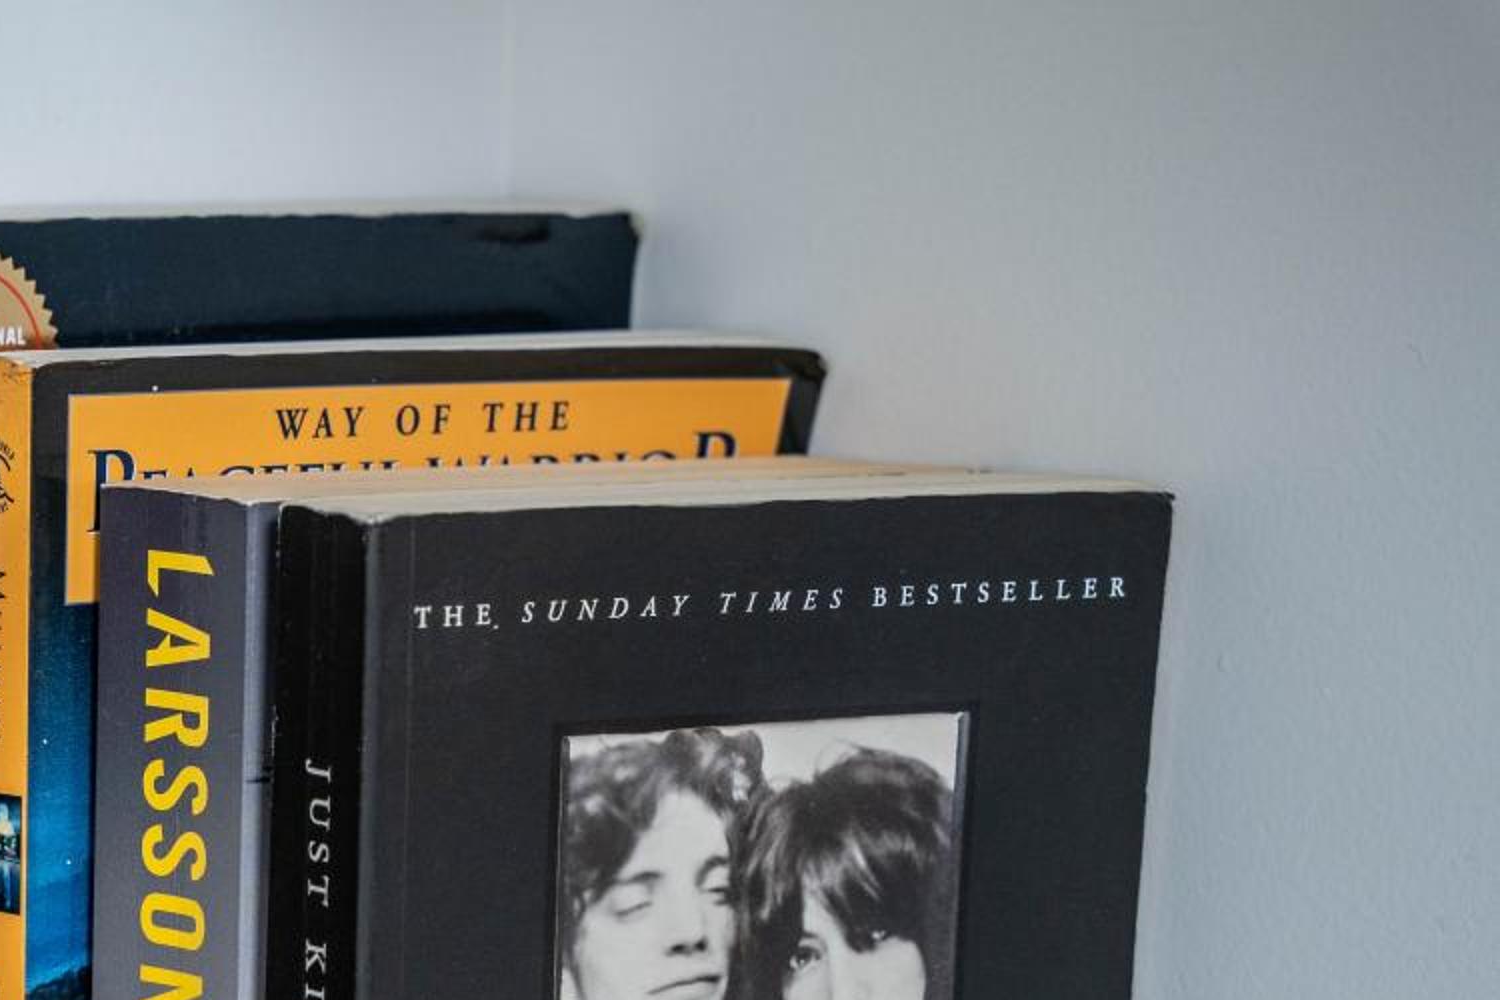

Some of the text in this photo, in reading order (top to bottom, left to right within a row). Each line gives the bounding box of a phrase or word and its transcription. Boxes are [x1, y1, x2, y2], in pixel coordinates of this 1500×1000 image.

[276, 401, 570, 440] WAY OF THE
[521, 595, 691, 624] SUNDAY
[719, 588, 844, 615] TIMES
[872, 577, 1127, 608] BESTSELLER
[304, 757, 332, 908] JUST
